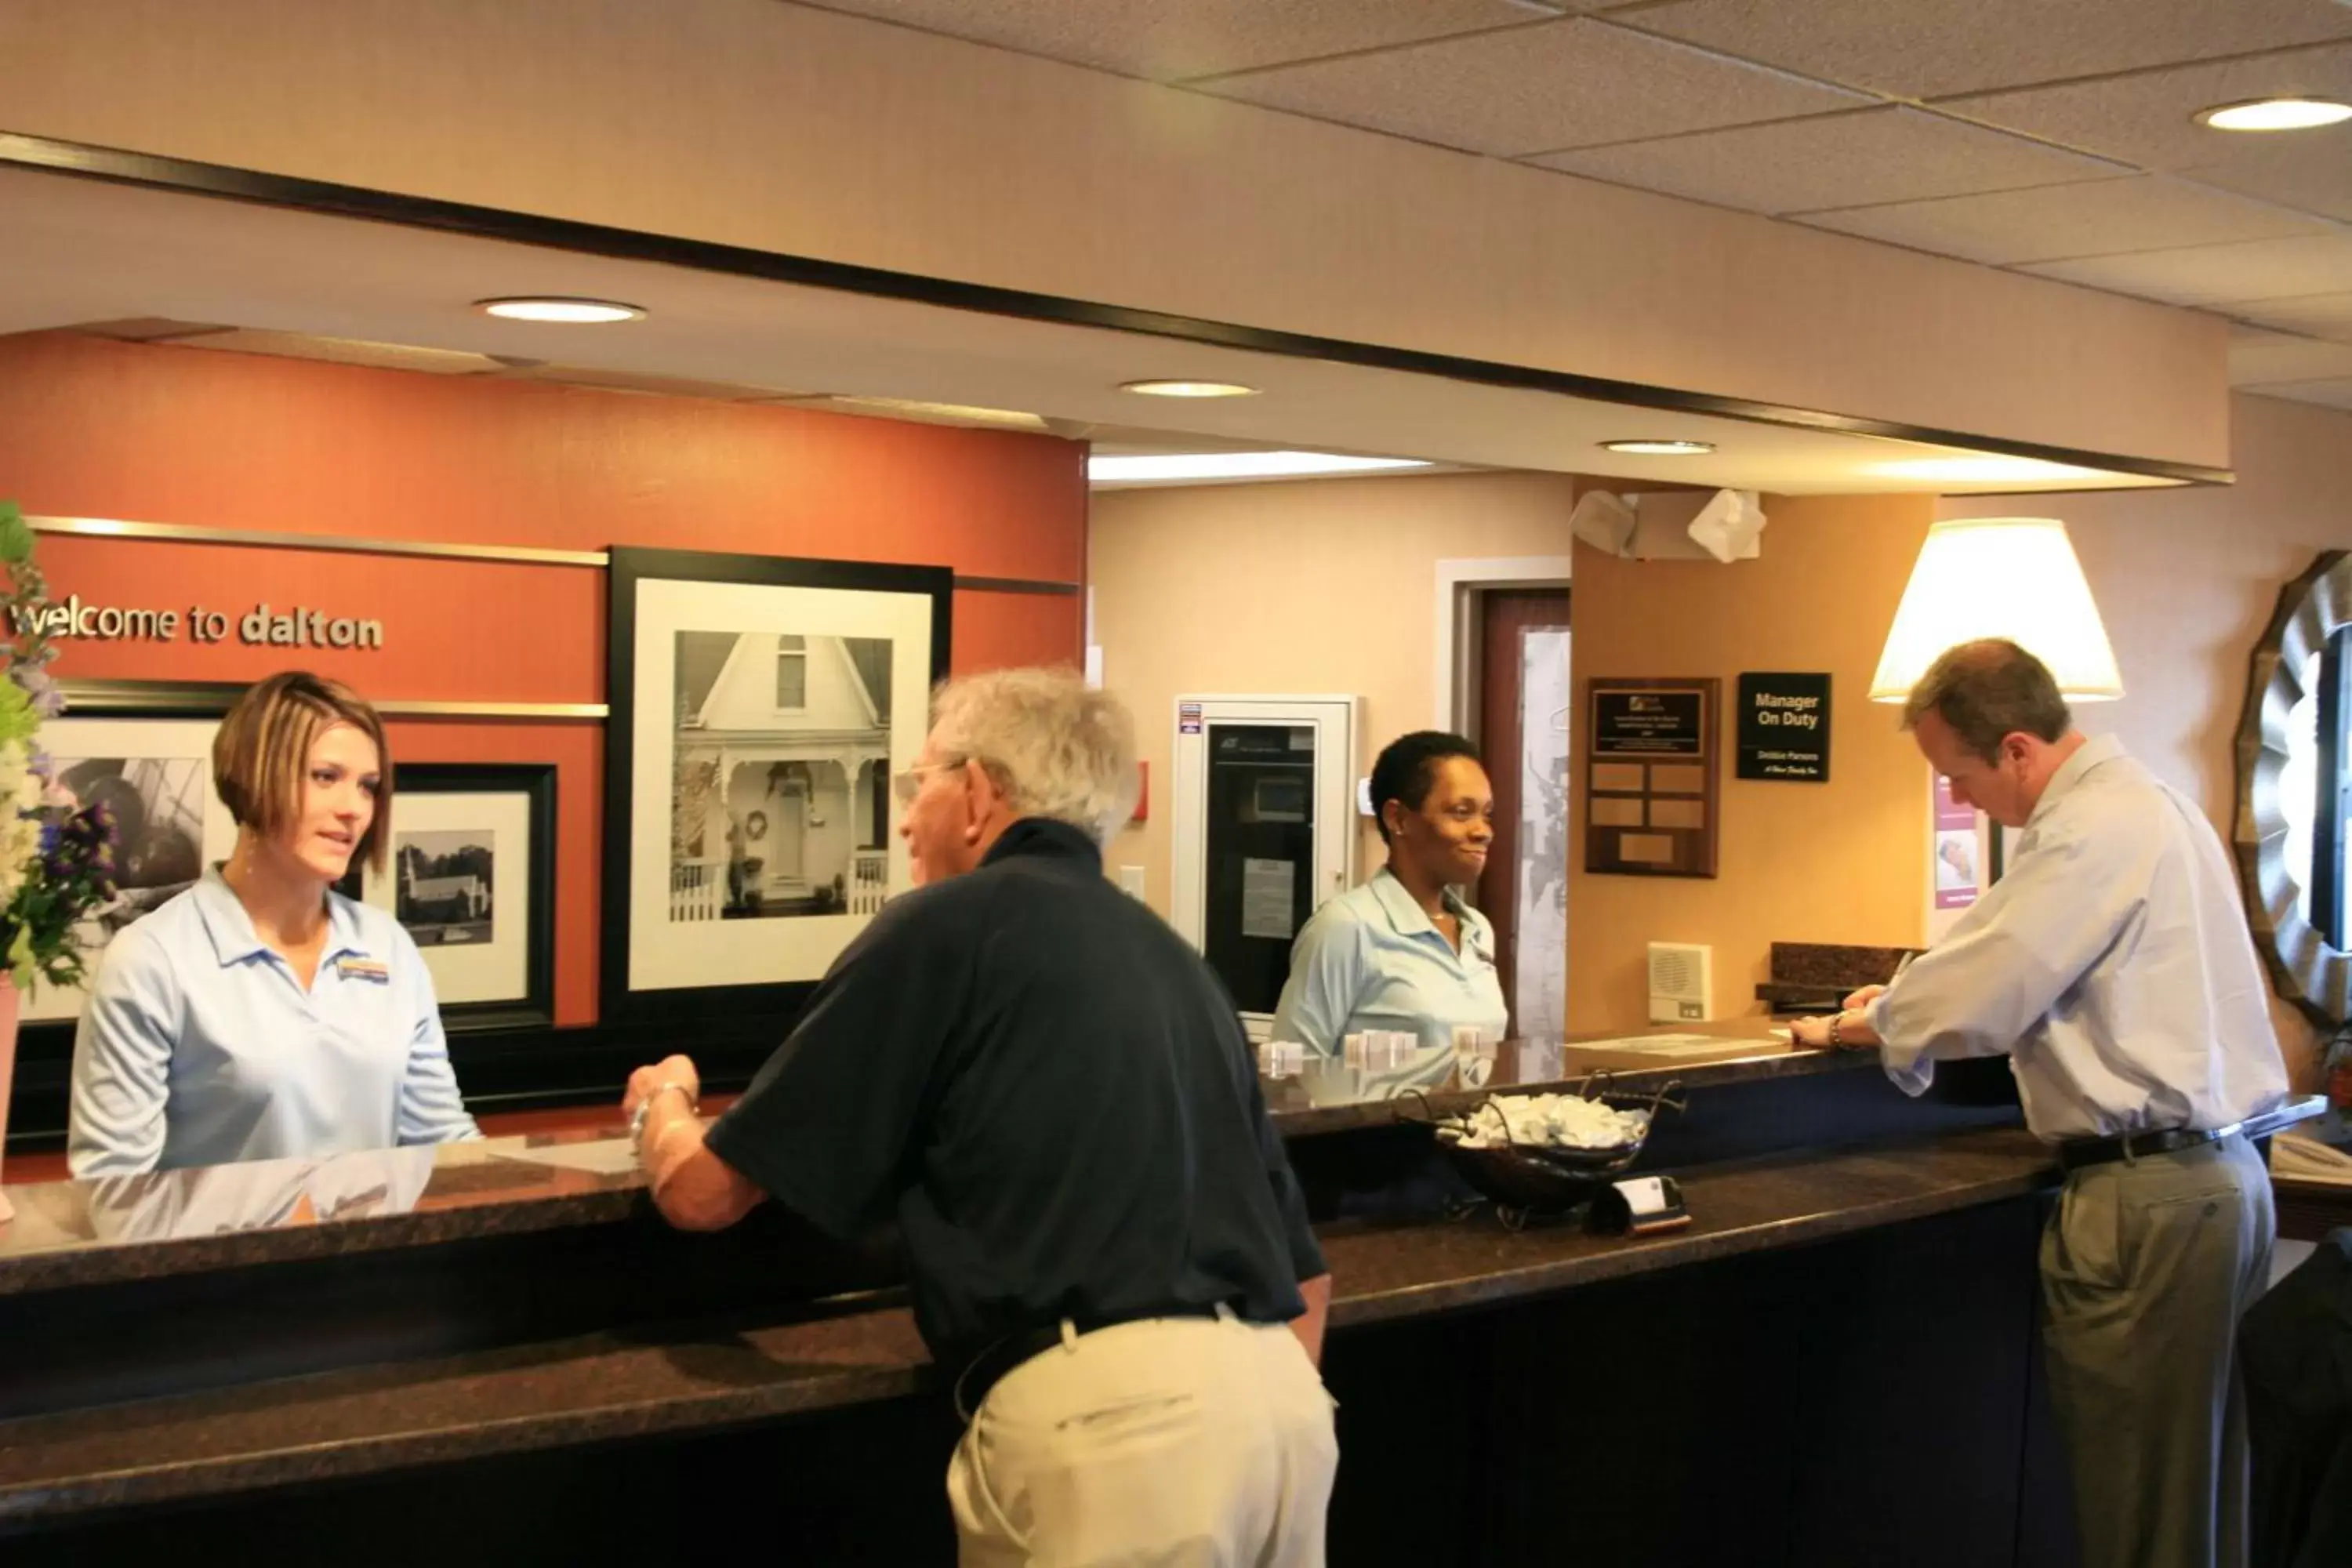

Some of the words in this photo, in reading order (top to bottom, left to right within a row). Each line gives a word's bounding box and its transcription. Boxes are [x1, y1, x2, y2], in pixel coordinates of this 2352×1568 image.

[191, 605, 228, 640] to
[241, 604, 384, 648] dalton
[1755, 692, 1819, 711] Manager
[1758, 710, 1780, 725] On
[1783, 711, 1818, 730] Duty
